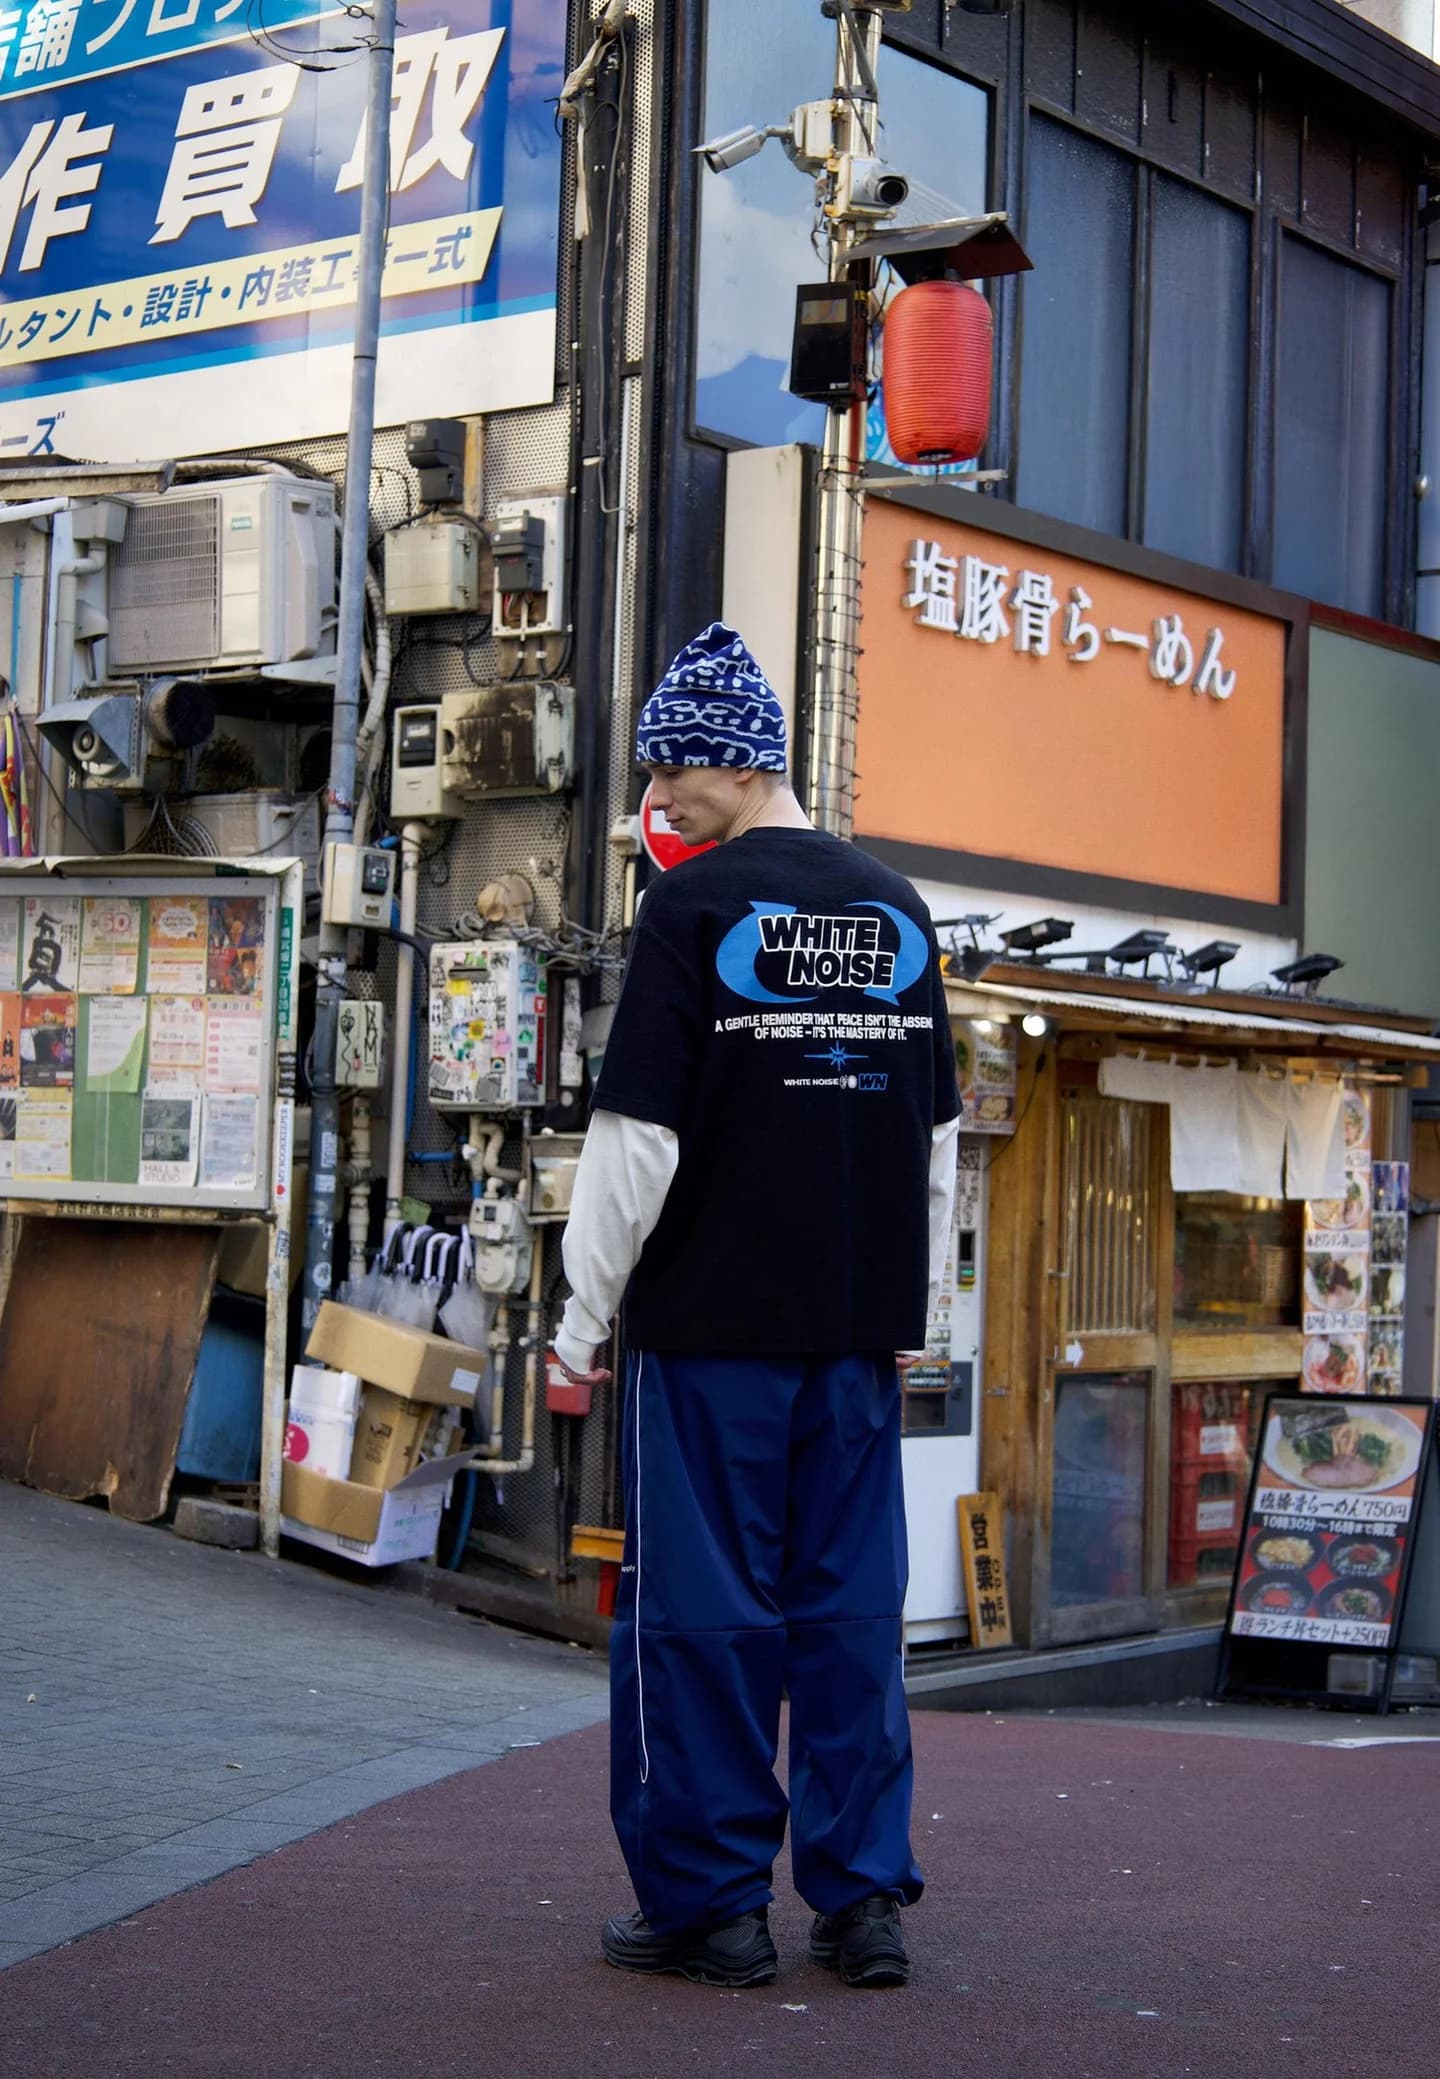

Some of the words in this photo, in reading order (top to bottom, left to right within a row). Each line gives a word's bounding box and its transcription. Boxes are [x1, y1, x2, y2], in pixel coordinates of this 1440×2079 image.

[0, 226, 472, 349] ルタント・設計・内装工一式
[902, 538, 1236, 701] 塩豚骨らーめん
[758, 914, 880, 952] WHITE
[787, 949, 895, 987] NOISE
[715, 1019, 723, 1033] A
[725, 1014, 760, 1031] GENTLE
[761, 1012, 814, 1026] REMINDER
[813, 1013, 835, 1025] THAT
[887, 1015, 901, 1028] THE
[754, 1027, 769, 1040] OF
[771, 1026, 804, 1039] NOISE
[827, 1026, 846, 1039] THE
[887, 1027, 897, 1040] OF
[783, 1078, 811, 1087] WHITE
[812, 1078, 840, 1086] NOISE
